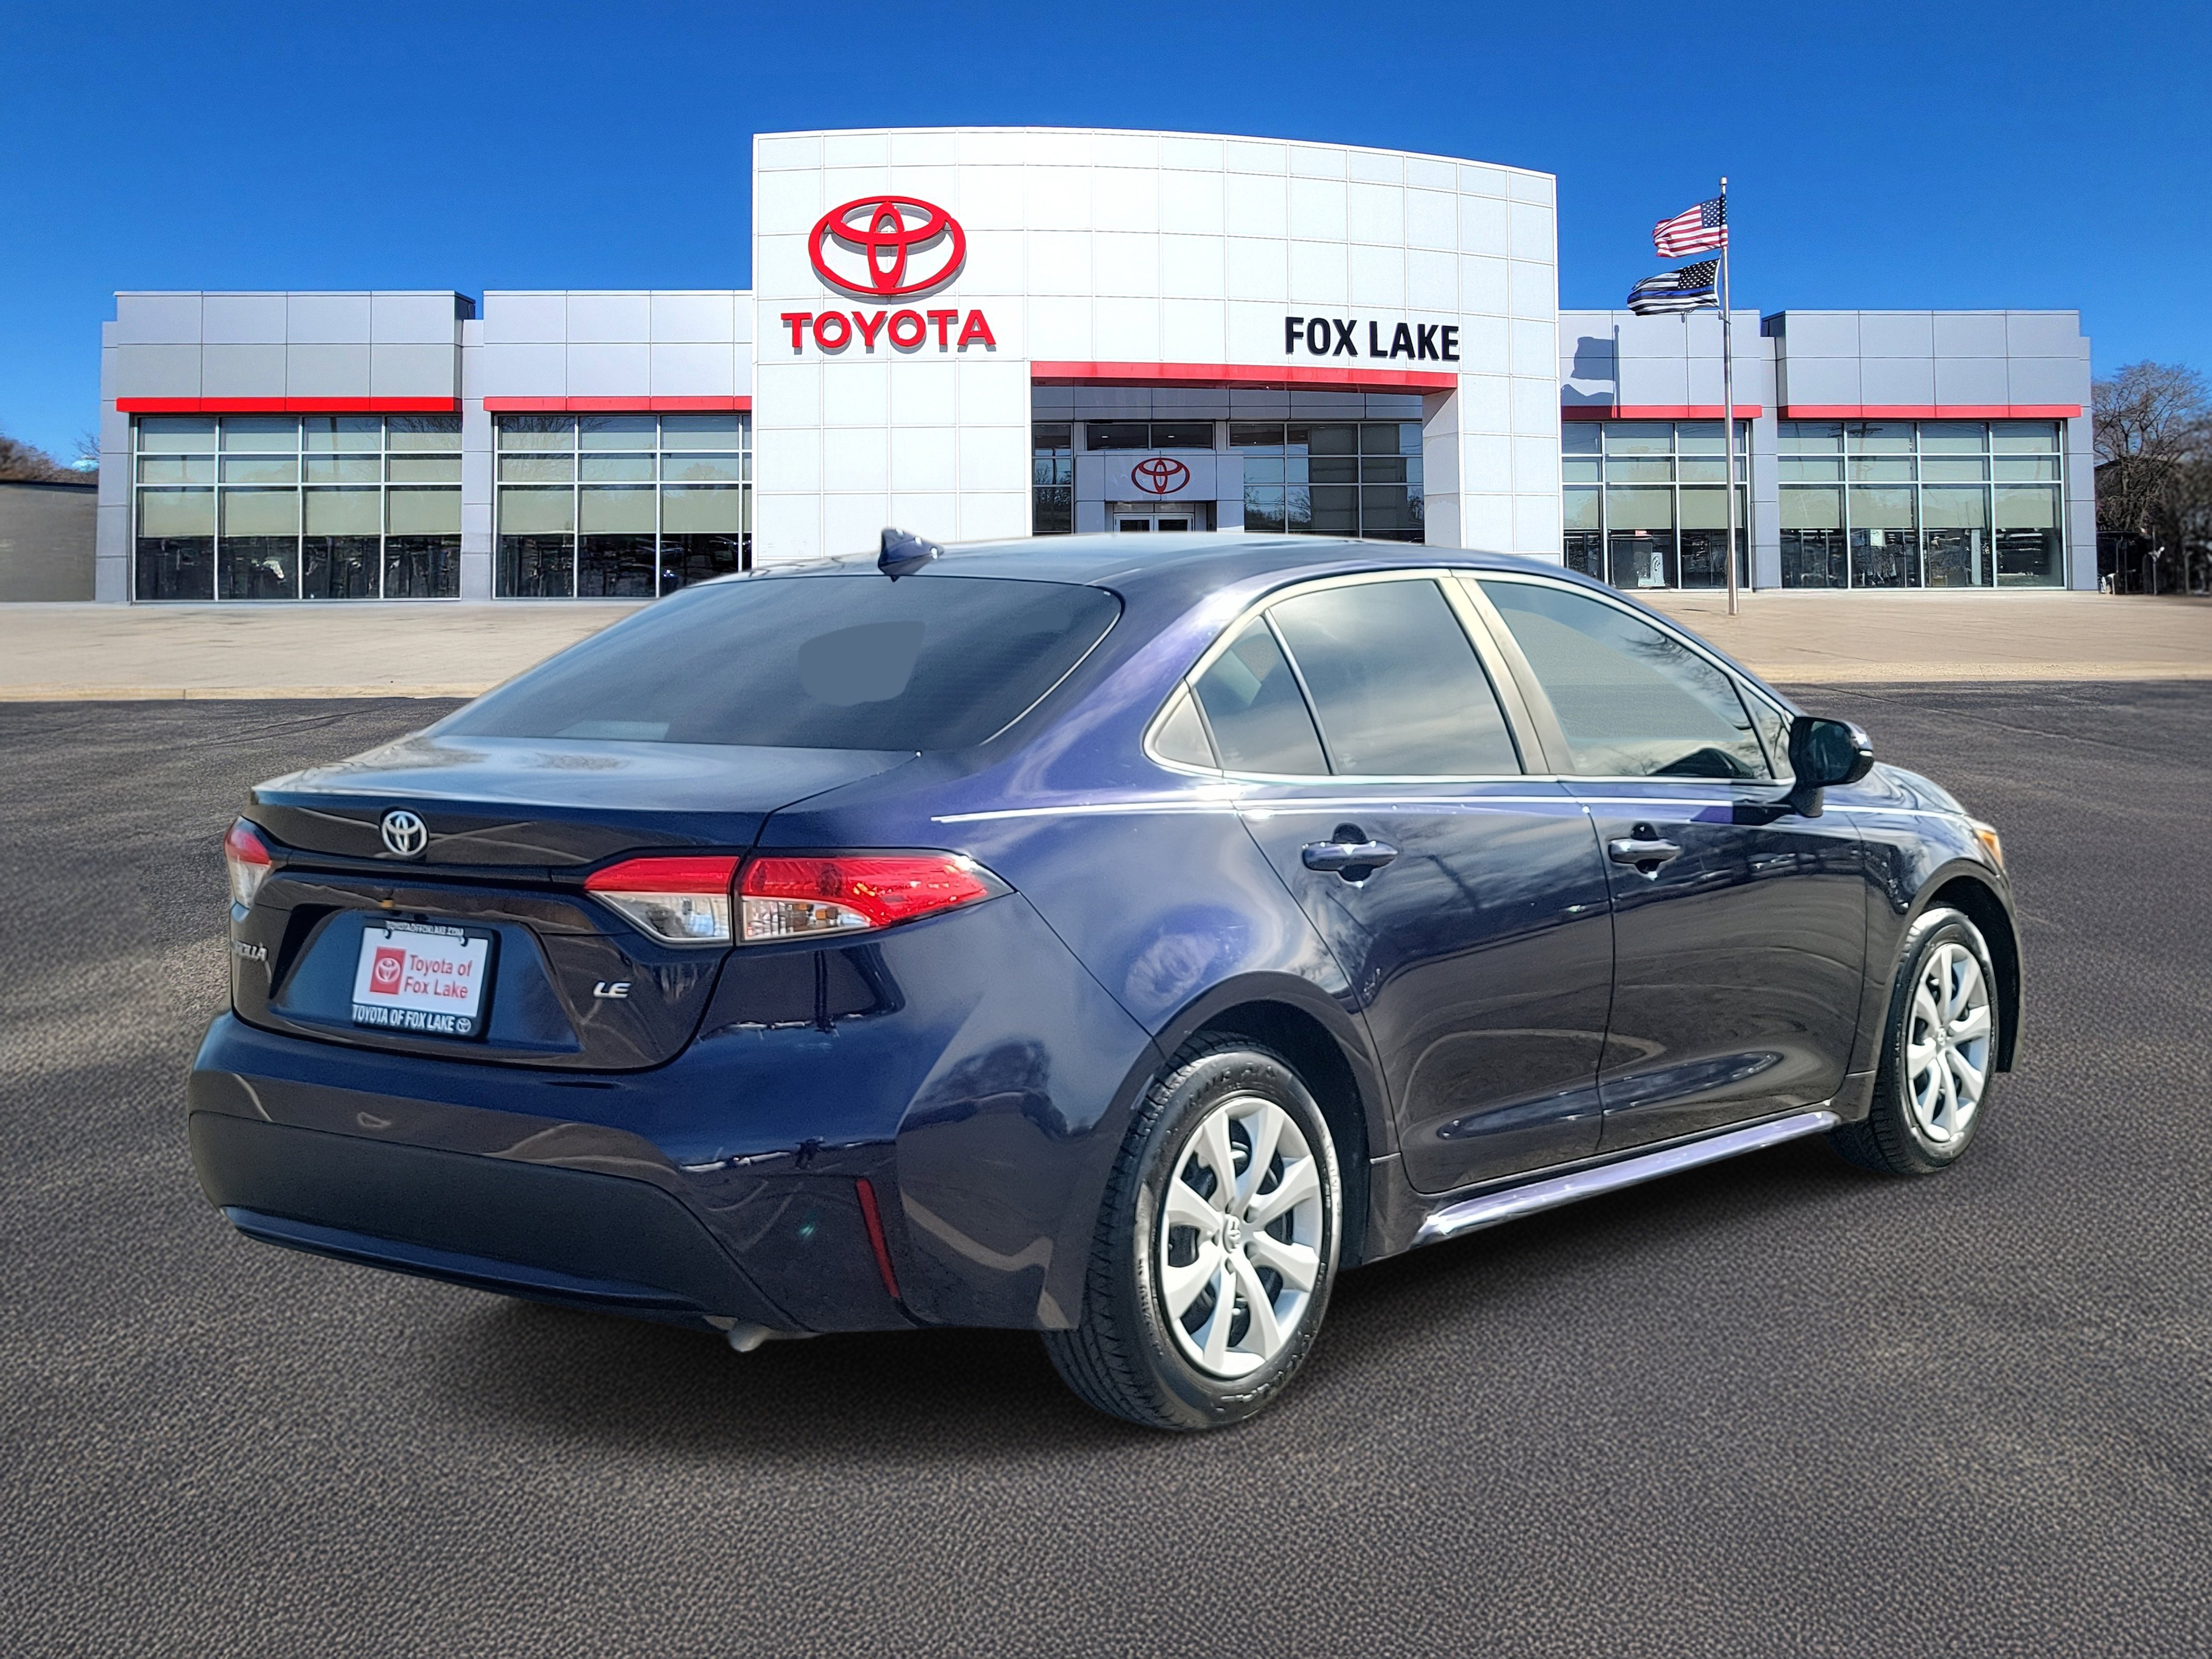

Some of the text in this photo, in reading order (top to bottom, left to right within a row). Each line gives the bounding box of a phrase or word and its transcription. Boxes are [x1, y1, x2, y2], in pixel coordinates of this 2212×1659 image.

[781, 309, 996, 349] TOYOTA
[1285, 316, 1460, 360] FOX LAKE
[410, 954, 473, 976] Toyota of
[404, 976, 468, 999] Fox Lake
[593, 982, 632, 998] LE
[352, 1004, 456, 1032] TOYOTA OF FOX LAKE
